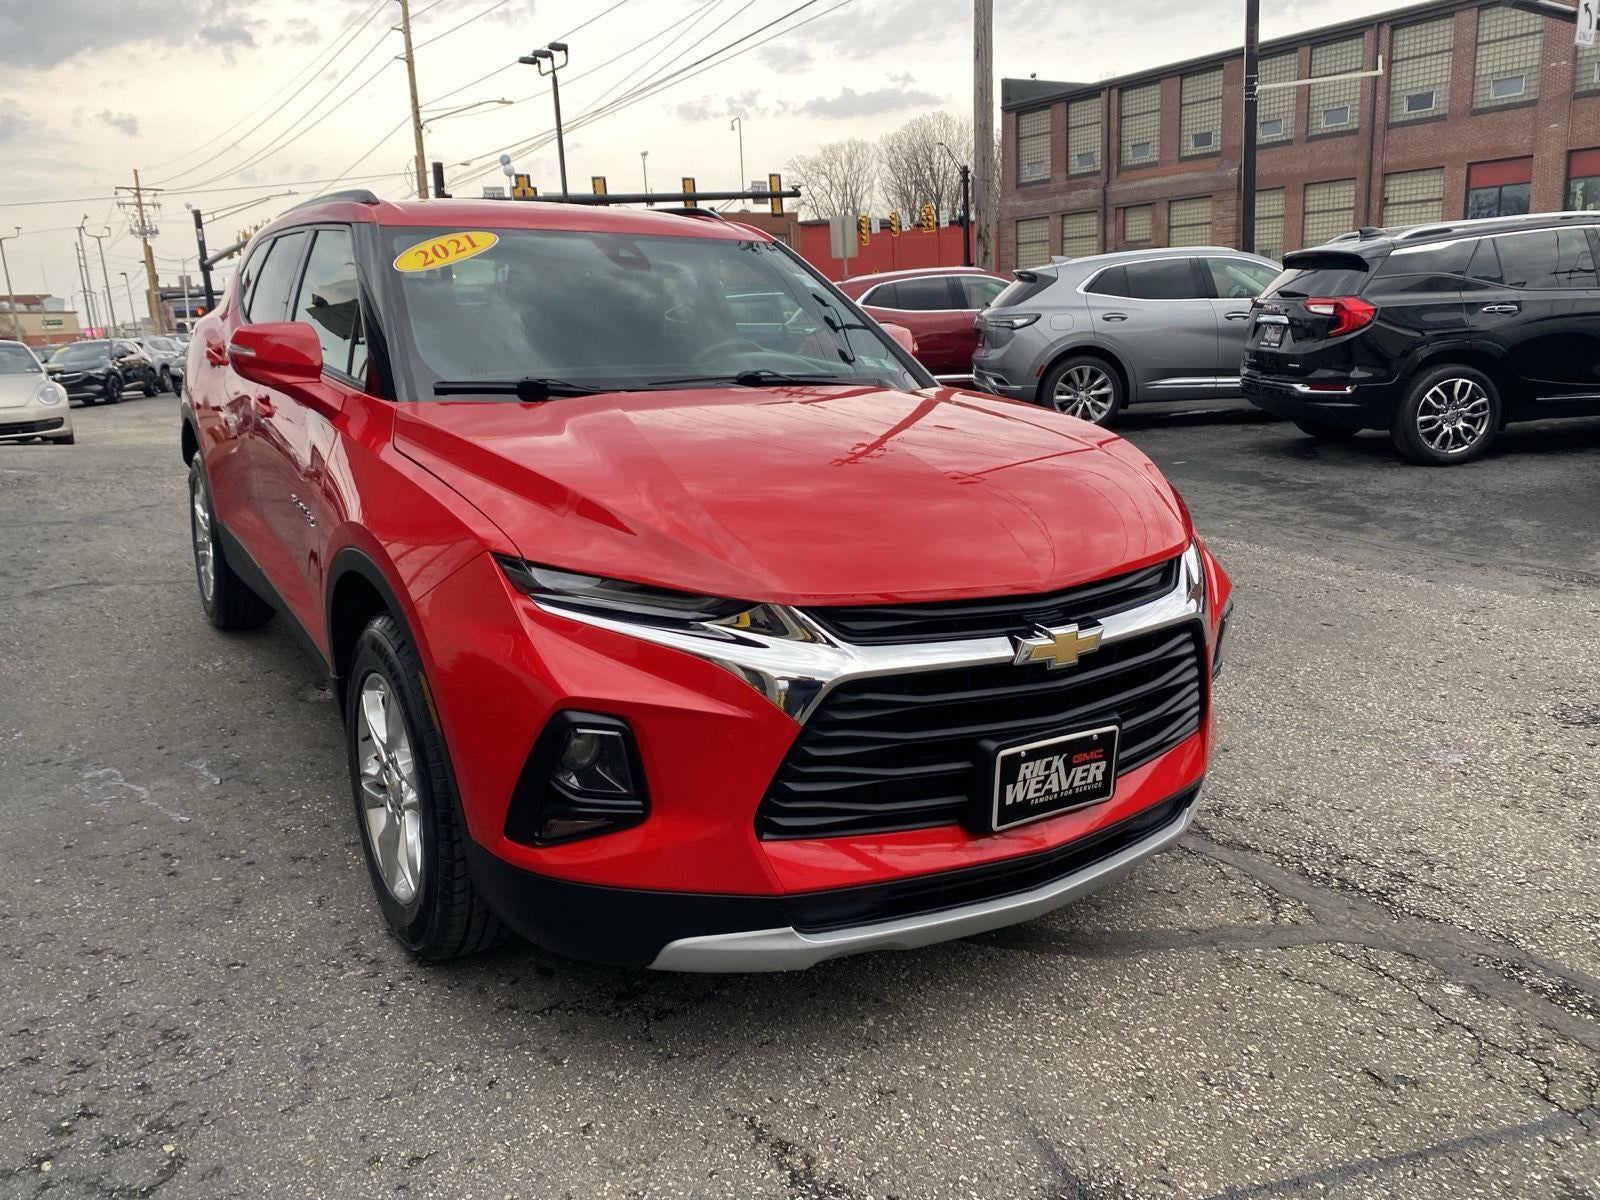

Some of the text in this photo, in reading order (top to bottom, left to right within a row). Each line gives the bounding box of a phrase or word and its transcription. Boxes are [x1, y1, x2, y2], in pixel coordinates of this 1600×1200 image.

[1578, 31, 1593, 42] ONLY
[414, 233, 478, 267] 2021
[1017, 753, 1068, 782] RICK
[1072, 748, 1104, 764] GMC
[1005, 760, 1107, 806] WEAVER
[1030, 781, 1103, 806] FAMOUS FOR SERVICE
